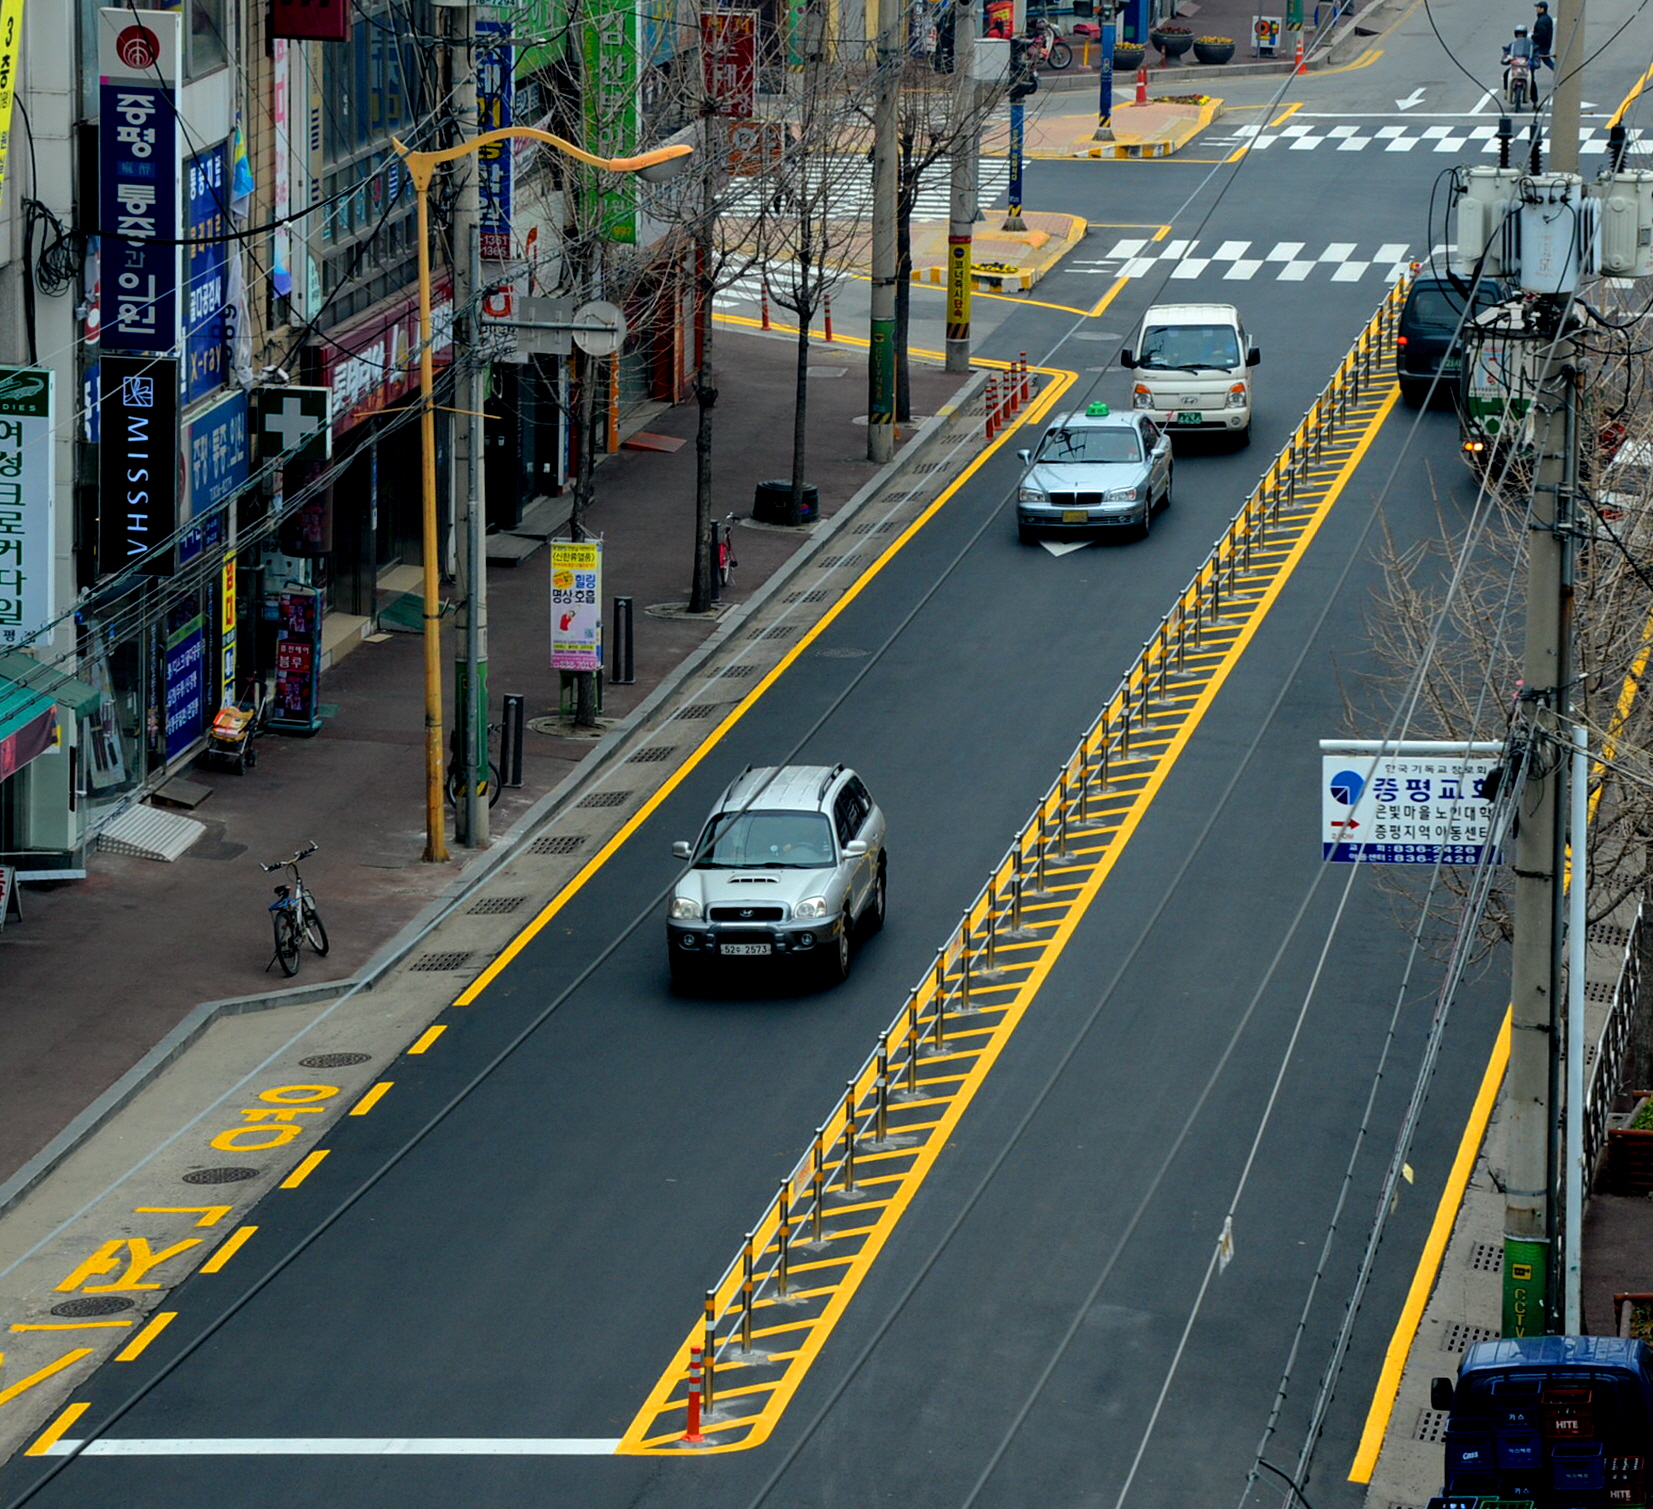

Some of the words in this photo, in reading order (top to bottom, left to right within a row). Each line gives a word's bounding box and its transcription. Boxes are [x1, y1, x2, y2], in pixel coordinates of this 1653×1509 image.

[117, 94, 156, 158] 증평
[127, 416, 149, 556] MISSHA
[575, 574, 596, 589] 힐링
[552, 589, 573, 604] 명상
[574, 589, 595, 604] 호흡
[745, 945, 768, 954] 2573
[1514, 1288, 1527, 1339] CCTV
[1508, 1413, 1525, 1421] 카스
[1555, 1420, 1579, 1430] HITE
[1610, 1489, 1632, 1499] HITE
